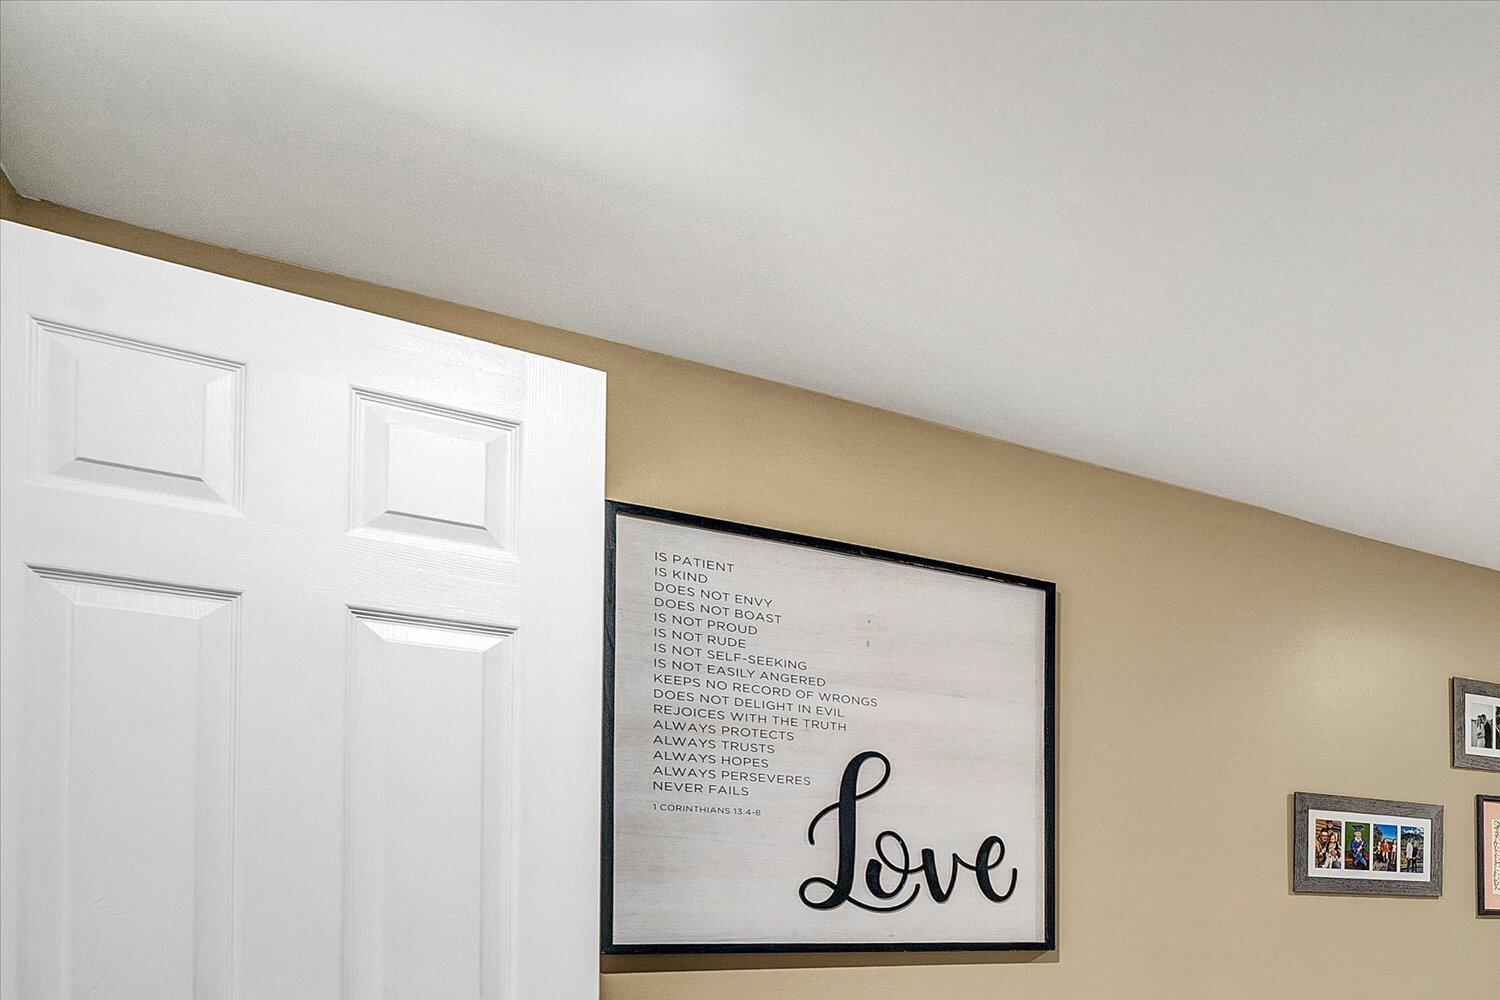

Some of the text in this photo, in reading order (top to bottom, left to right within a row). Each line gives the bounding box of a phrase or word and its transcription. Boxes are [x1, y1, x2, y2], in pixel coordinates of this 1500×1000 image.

[655, 552, 735, 572] IS PATIENT
[655, 567, 708, 583] IS KIND
[654, 582, 772, 608] DOES NOT ENVY
[654, 598, 782, 623] DOES NOT BOAST
[654, 613, 758, 635] IS NOT PROUD
[654, 628, 746, 648] IS NOT RUDE
[654, 644, 807, 670] IS NOT SELF-SEEKING
[654, 659, 826, 686] IS NOT EASILY ANGERED
[654, 674, 877, 707] KEEPS NO RECORD OF WRONGS
[654, 690, 844, 717] DOES NOT DELIGHT IN EVIL
[654, 705, 847, 731] REJOICES WITH THE TRUTH
[653, 720, 795, 740] ALWAYS PROTECTS
[653, 736, 774, 753] ALWAYS TRUSTS
[653, 751, 769, 768] ALWAYS HOPES
[653, 766, 811, 785] ALWAYS PERSEVERES
[653, 782, 749, 796] NEVER FAILS
[660, 804, 730, 814] CORINTHIANS
[799, 751, 1017, 912] Love
